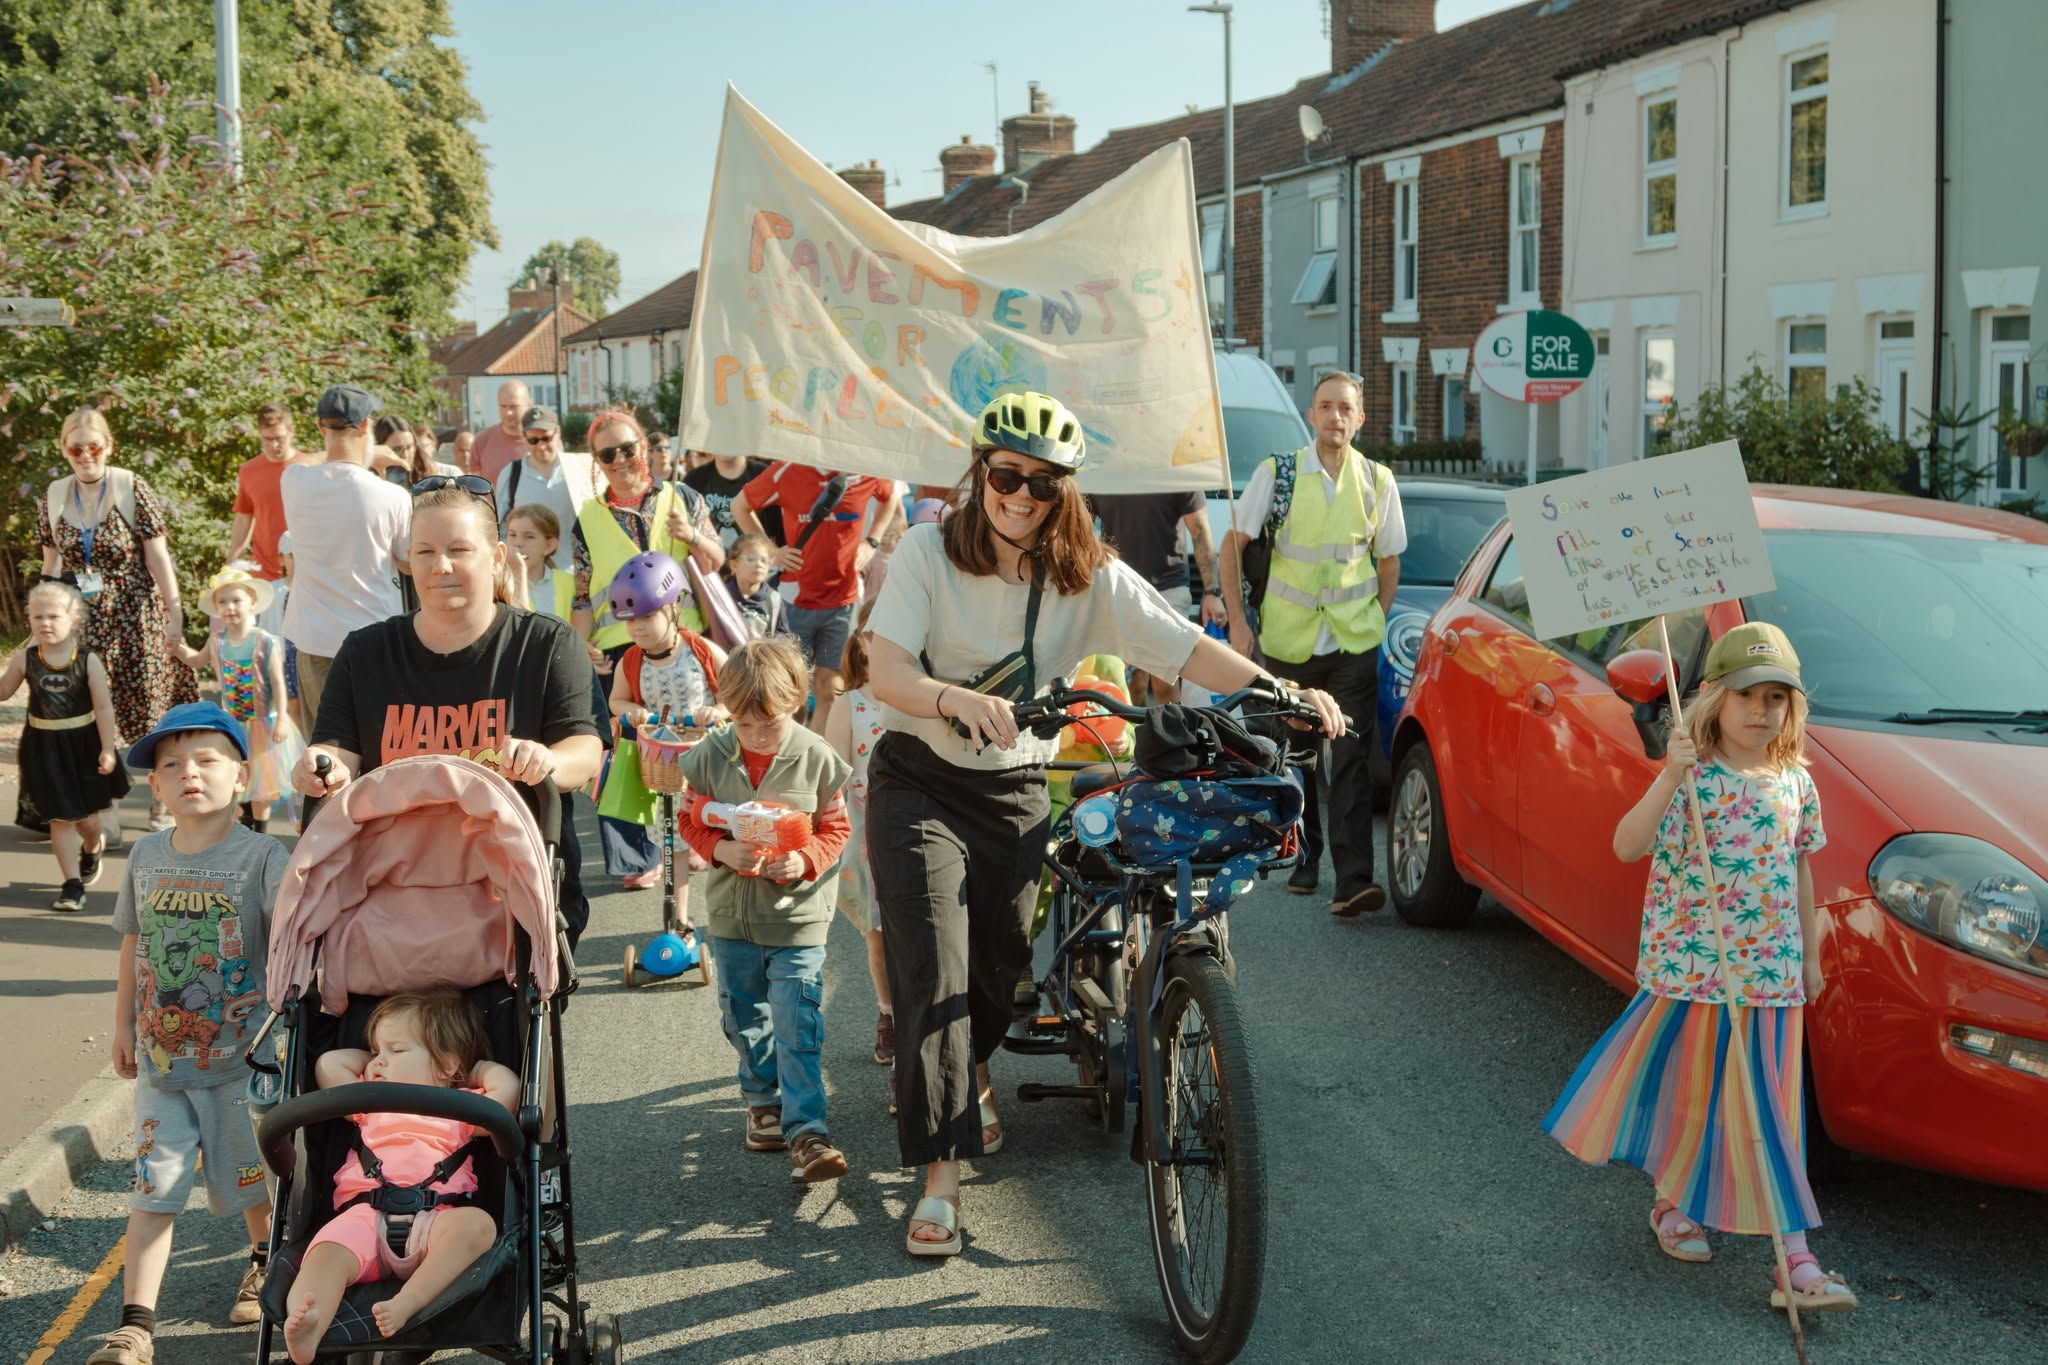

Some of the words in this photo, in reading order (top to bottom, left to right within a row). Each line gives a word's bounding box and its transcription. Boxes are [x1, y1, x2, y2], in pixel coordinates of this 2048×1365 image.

[749, 210, 1174, 335] PAVEMENTS
[830, 306, 927, 367] FOR
[1531, 336, 1571, 353] FOR
[1531, 354, 1579, 371] SALE
[714, 355, 905, 428] PEOPLE
[1621, 524, 1644, 538] on
[381, 699, 506, 750] MARVEL
[154, 867, 178, 875] MARVEL
[179, 868, 207, 877] COMICS
[146, 889, 239, 918] HEROES
